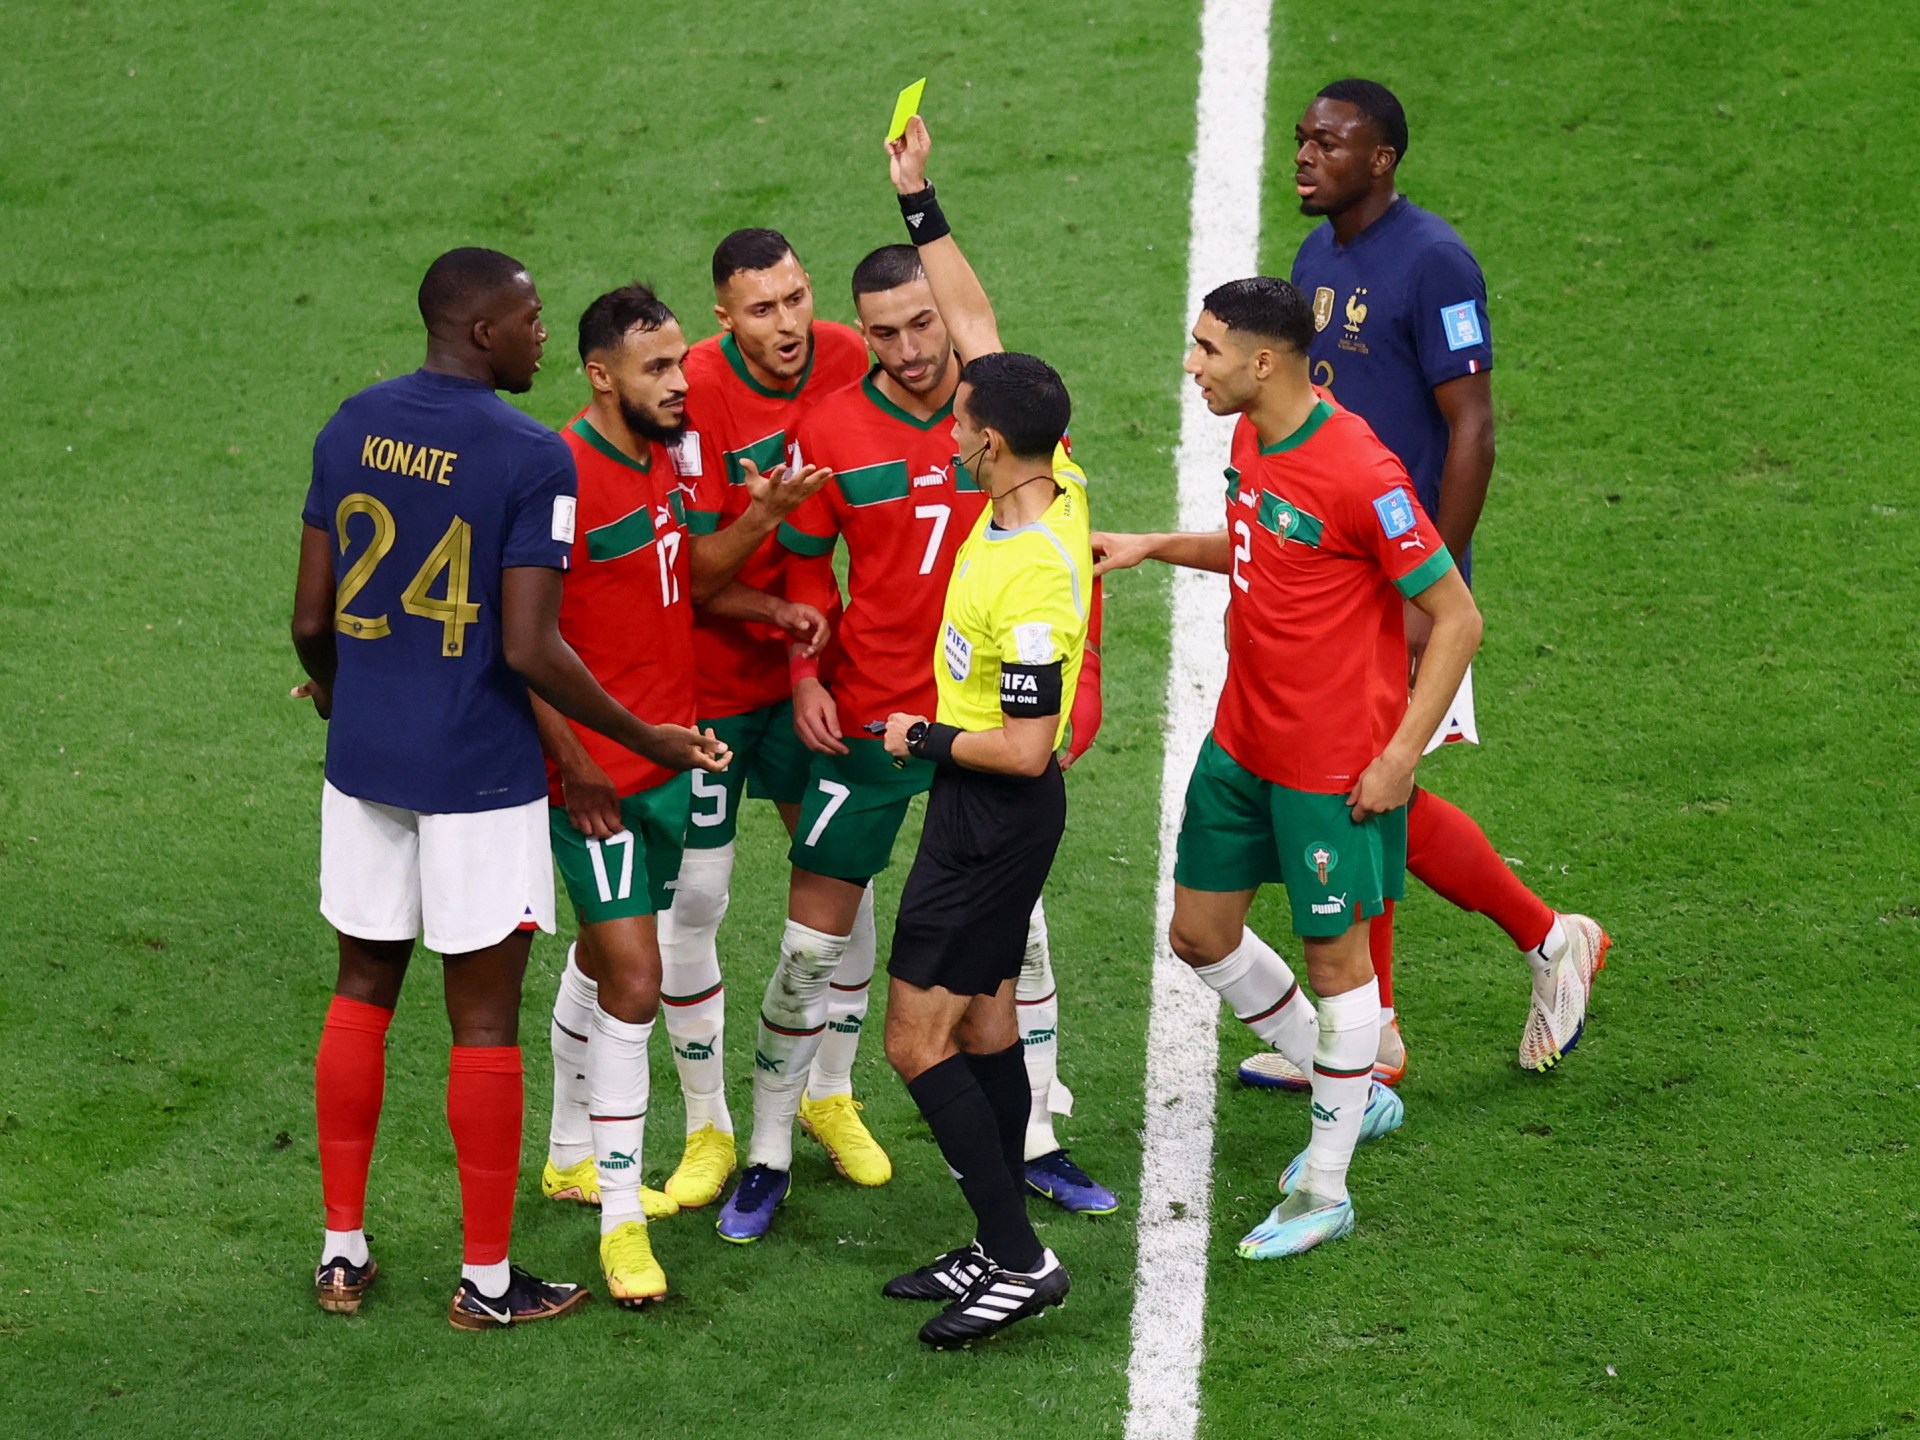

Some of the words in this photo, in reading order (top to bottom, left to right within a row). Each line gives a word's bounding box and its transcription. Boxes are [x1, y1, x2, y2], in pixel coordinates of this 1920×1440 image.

[361, 435, 458, 486] KONATE
[913, 474, 943, 488] PUMA
[915, 504, 951, 575] 7
[1233, 519, 1251, 593] 2
[335, 492, 482, 657] 24
[656, 531, 682, 608] 17
[947, 625, 968, 657] FIFA
[1001, 693, 1016, 703] AM
[1017, 695, 1038, 705] ONE
[804, 778, 851, 847] 7
[585, 829, 634, 903] 17
[1311, 903, 1341, 914] PUMA
[828, 1021, 859, 1034] PUMA
[1021, 1034, 1051, 1046] UMA
[600, 1160, 630, 1170] PUMA
